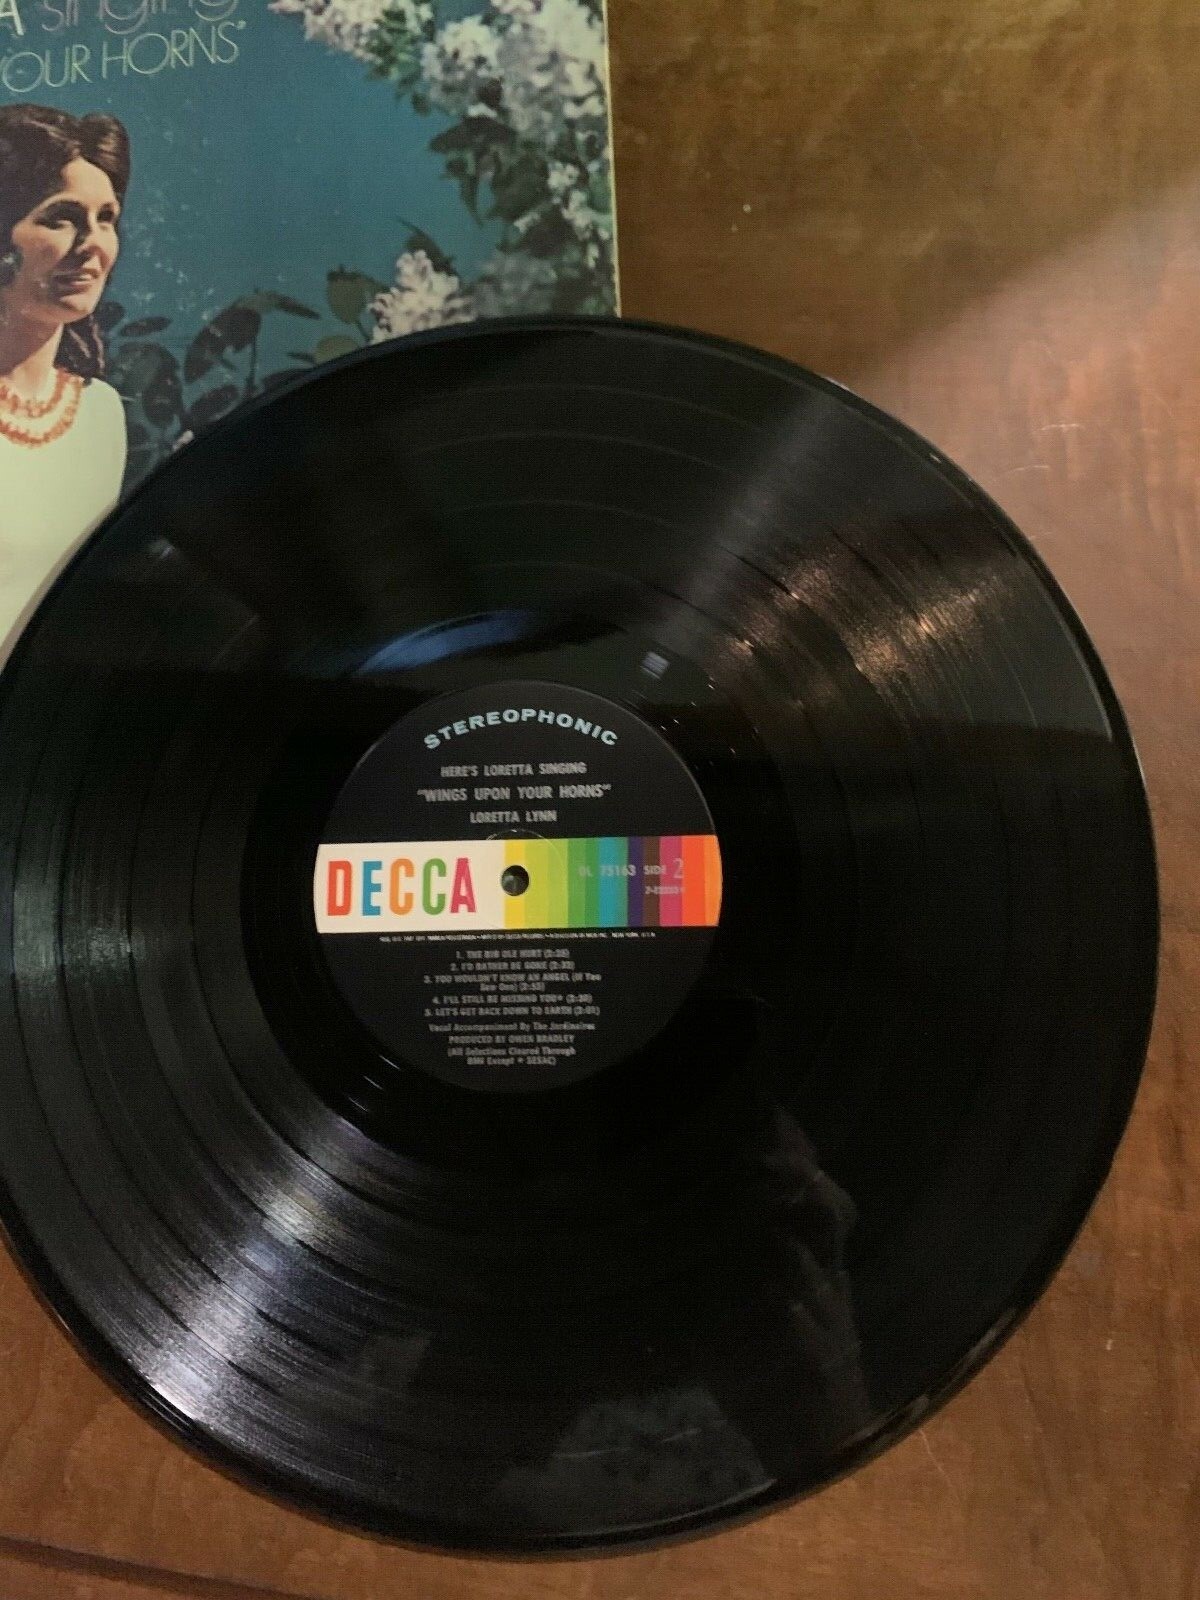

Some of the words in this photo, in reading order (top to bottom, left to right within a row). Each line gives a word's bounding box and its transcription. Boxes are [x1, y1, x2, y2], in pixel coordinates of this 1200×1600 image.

[0, 44, 93, 92] OUR
[424, 708, 618, 749] STEREOPHONIC
[440, 765, 478, 777] HERE'S
[484, 763, 534, 776] LORETTA
[539, 761, 587, 774] SINGING
[474, 786, 511, 800] UPON
[517, 785, 552, 799] YOUR
[470, 811, 520, 824] LORETTA
[525, 810, 557, 822] LYNN
[643, 864, 667, 875] SIDE
[674, 857, 685, 879] 2
[327, 857, 476, 916] DECCA
